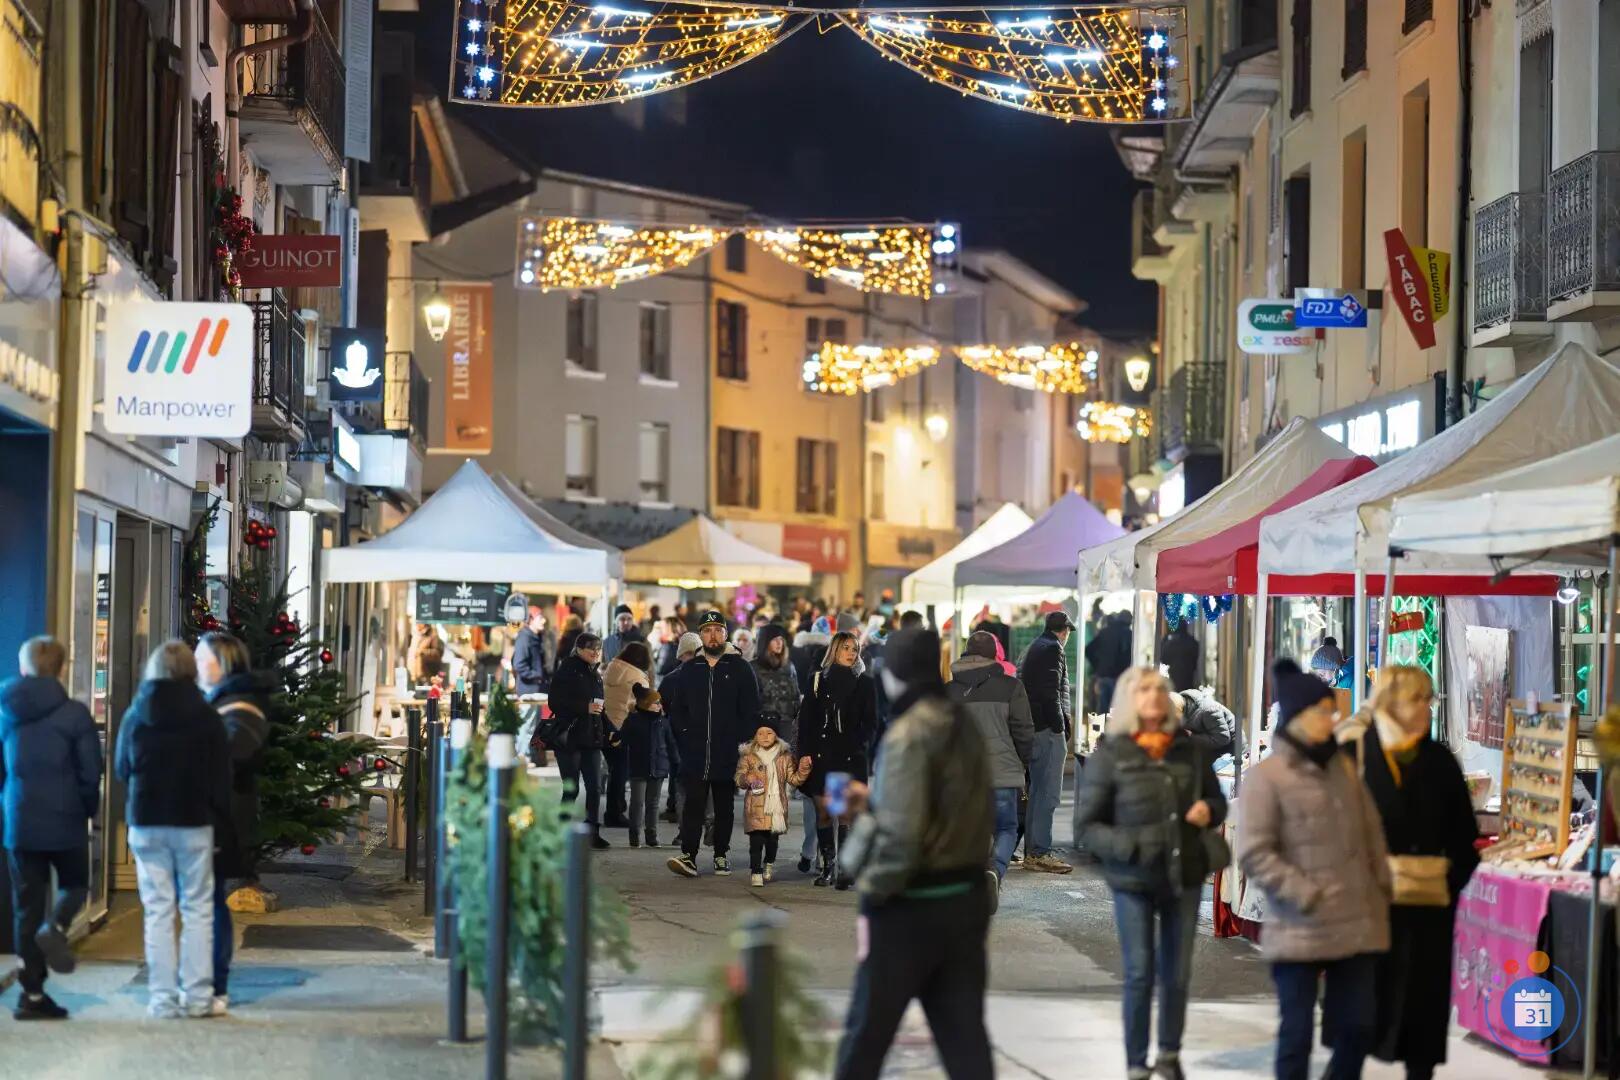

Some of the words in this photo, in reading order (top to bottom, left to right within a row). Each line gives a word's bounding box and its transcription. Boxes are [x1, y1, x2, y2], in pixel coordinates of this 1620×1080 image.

[244, 248, 337, 267] GUINOT
[1395, 254, 1426, 323] TABAC
[1428, 252, 1443, 313] PRESSE
[1306, 301, 1334, 314] FDJ
[1253, 314, 1283, 324] PMU
[452, 293, 470, 401] LIBRAIRIE
[1242, 335, 1316, 347] exress
[117, 396, 236, 421] Manpower
